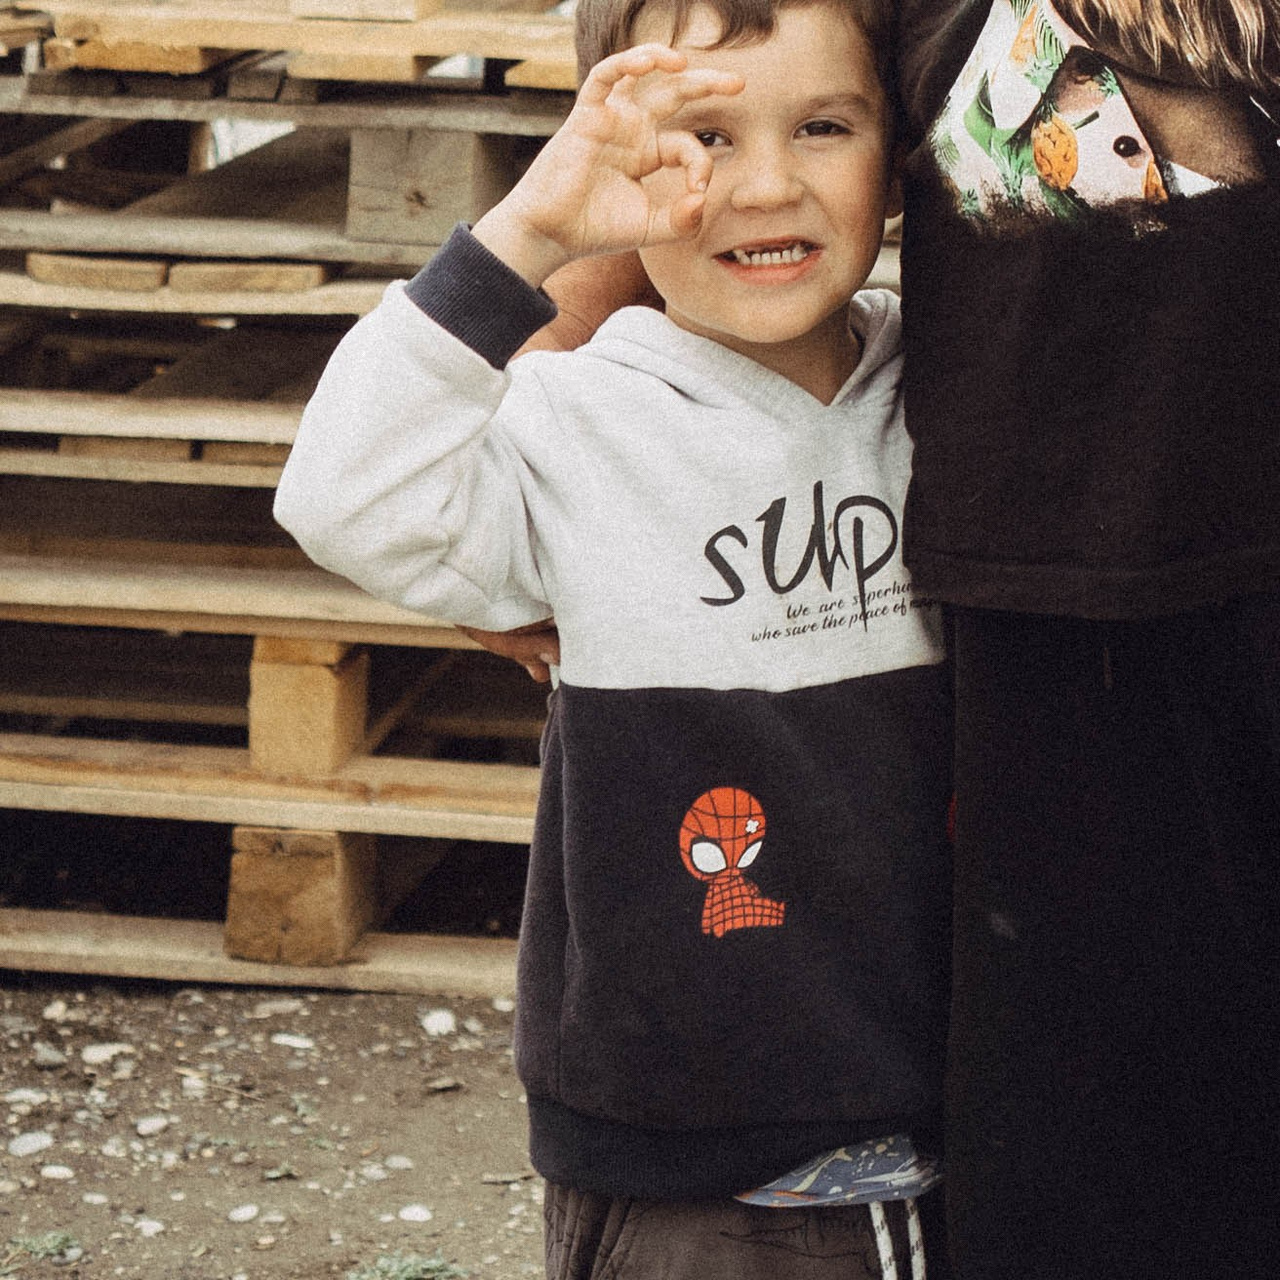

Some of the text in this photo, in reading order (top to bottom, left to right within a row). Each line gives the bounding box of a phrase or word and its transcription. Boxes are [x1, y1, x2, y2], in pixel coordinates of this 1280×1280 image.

[751, 627, 781, 642] who
[786, 621, 819, 637] save
[822, 613, 847, 630] the
[849, 607, 889, 628] peace
[893, 597, 907, 616] of
[787, 604, 810, 620] We
[819, 599, 845, 614] are
